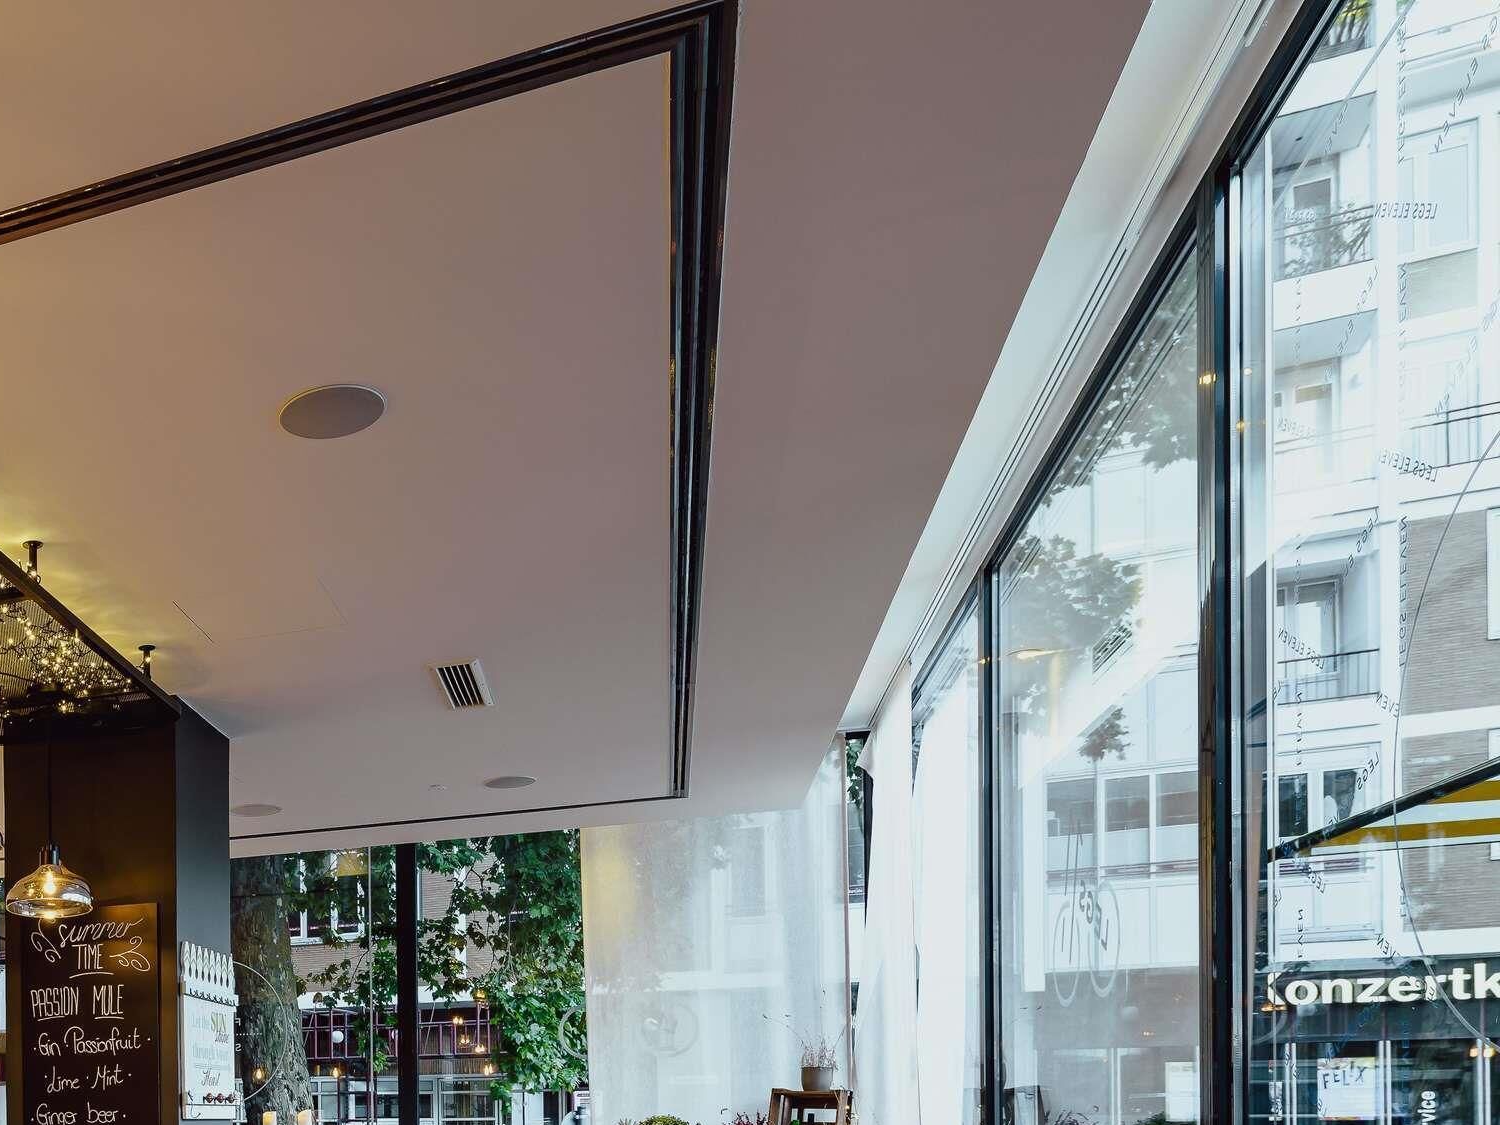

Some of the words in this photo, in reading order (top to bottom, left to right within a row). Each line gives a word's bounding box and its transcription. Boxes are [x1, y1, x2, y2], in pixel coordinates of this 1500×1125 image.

[71, 943, 104, 970] TIME
[30, 985, 79, 1018] PASSION
[92, 984, 125, 1016] MULE
[38, 1032, 61, 1056] Gin
[64, 1026, 141, 1056] Passionfruit
[47, 1065, 81, 1093] Lime
[91, 1063, 124, 1091] Mint
